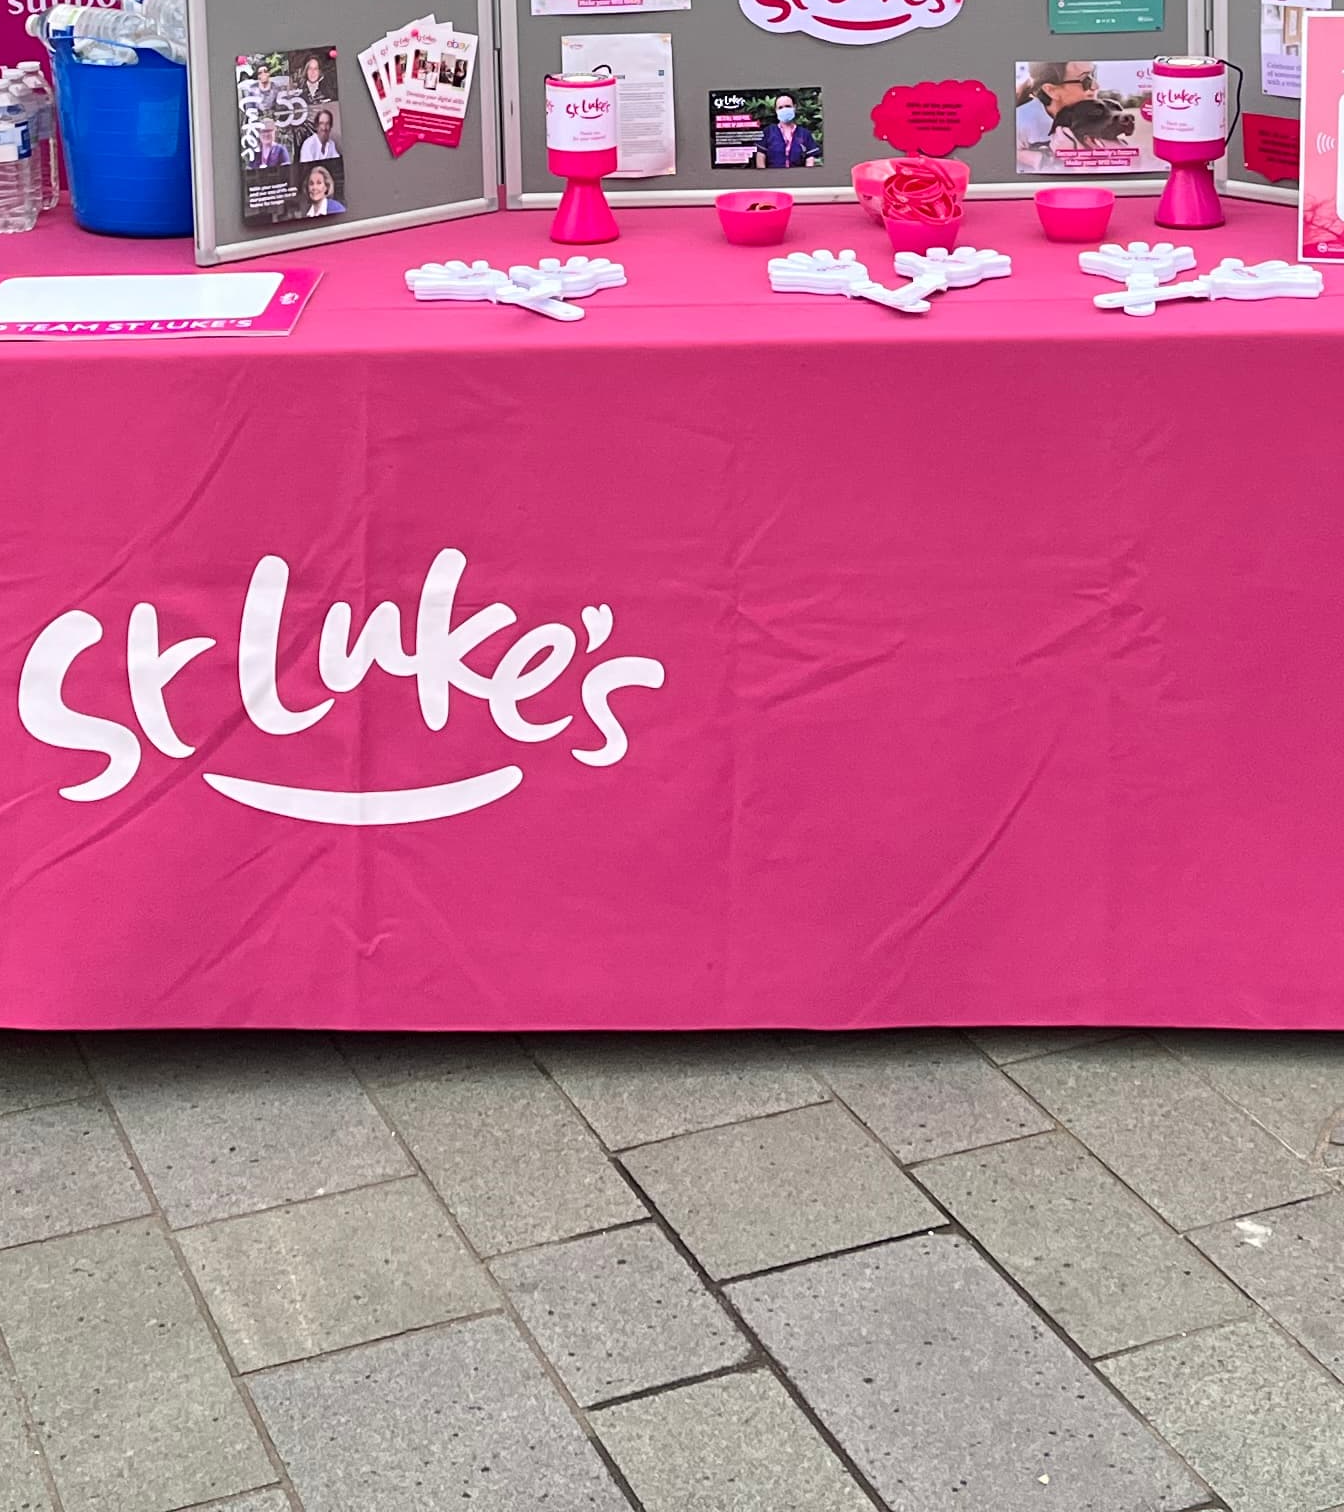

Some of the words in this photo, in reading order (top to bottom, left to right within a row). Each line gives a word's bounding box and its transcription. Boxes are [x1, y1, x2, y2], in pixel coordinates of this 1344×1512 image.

[16, 322, 100, 333] TEAM
[106, 322, 145, 332] ST
[149, 319, 254, 331] LUKE'S
[18, 601, 217, 802] St
[238, 547, 666, 767] Luke's
